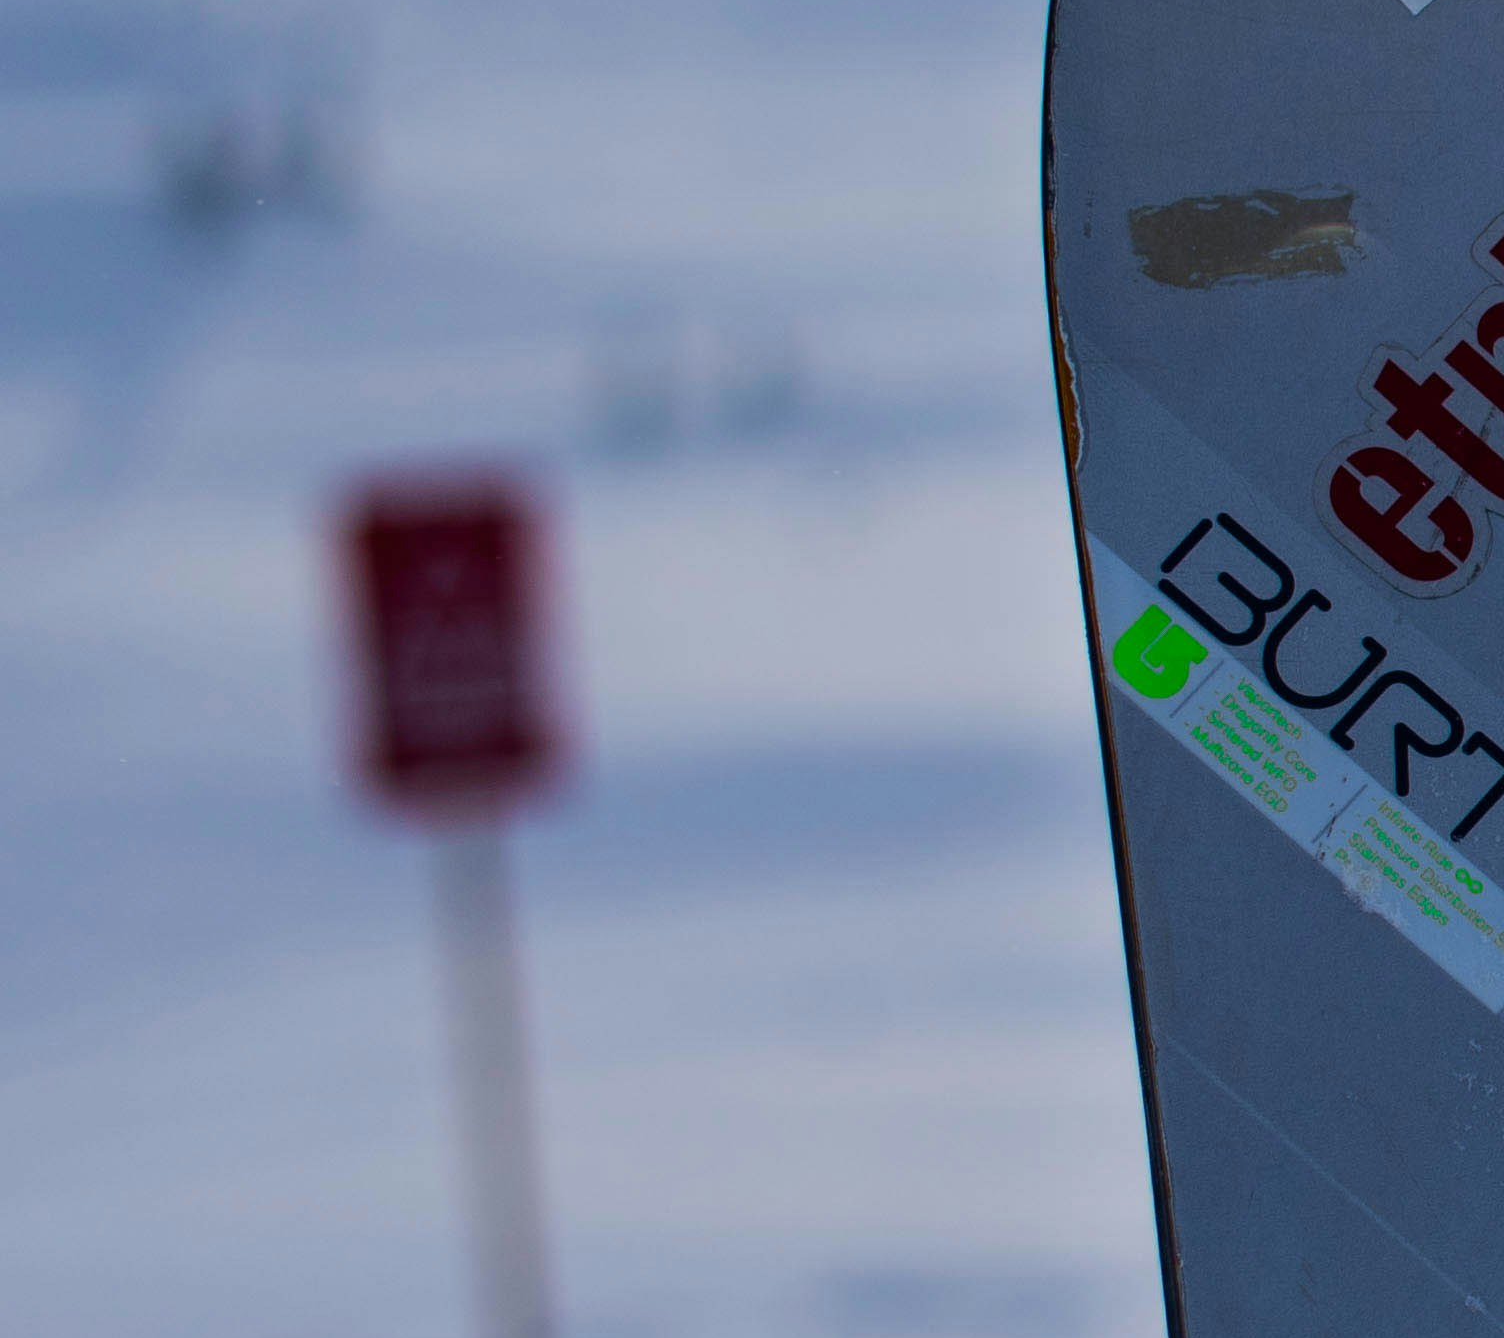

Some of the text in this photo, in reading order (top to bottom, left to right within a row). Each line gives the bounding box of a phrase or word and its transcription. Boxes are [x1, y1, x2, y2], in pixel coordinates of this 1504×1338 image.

[1283, 748, 1318, 783] Core
[1362, 815, 1422, 871] Pressure
[1406, 884, 1450, 926] Edges
